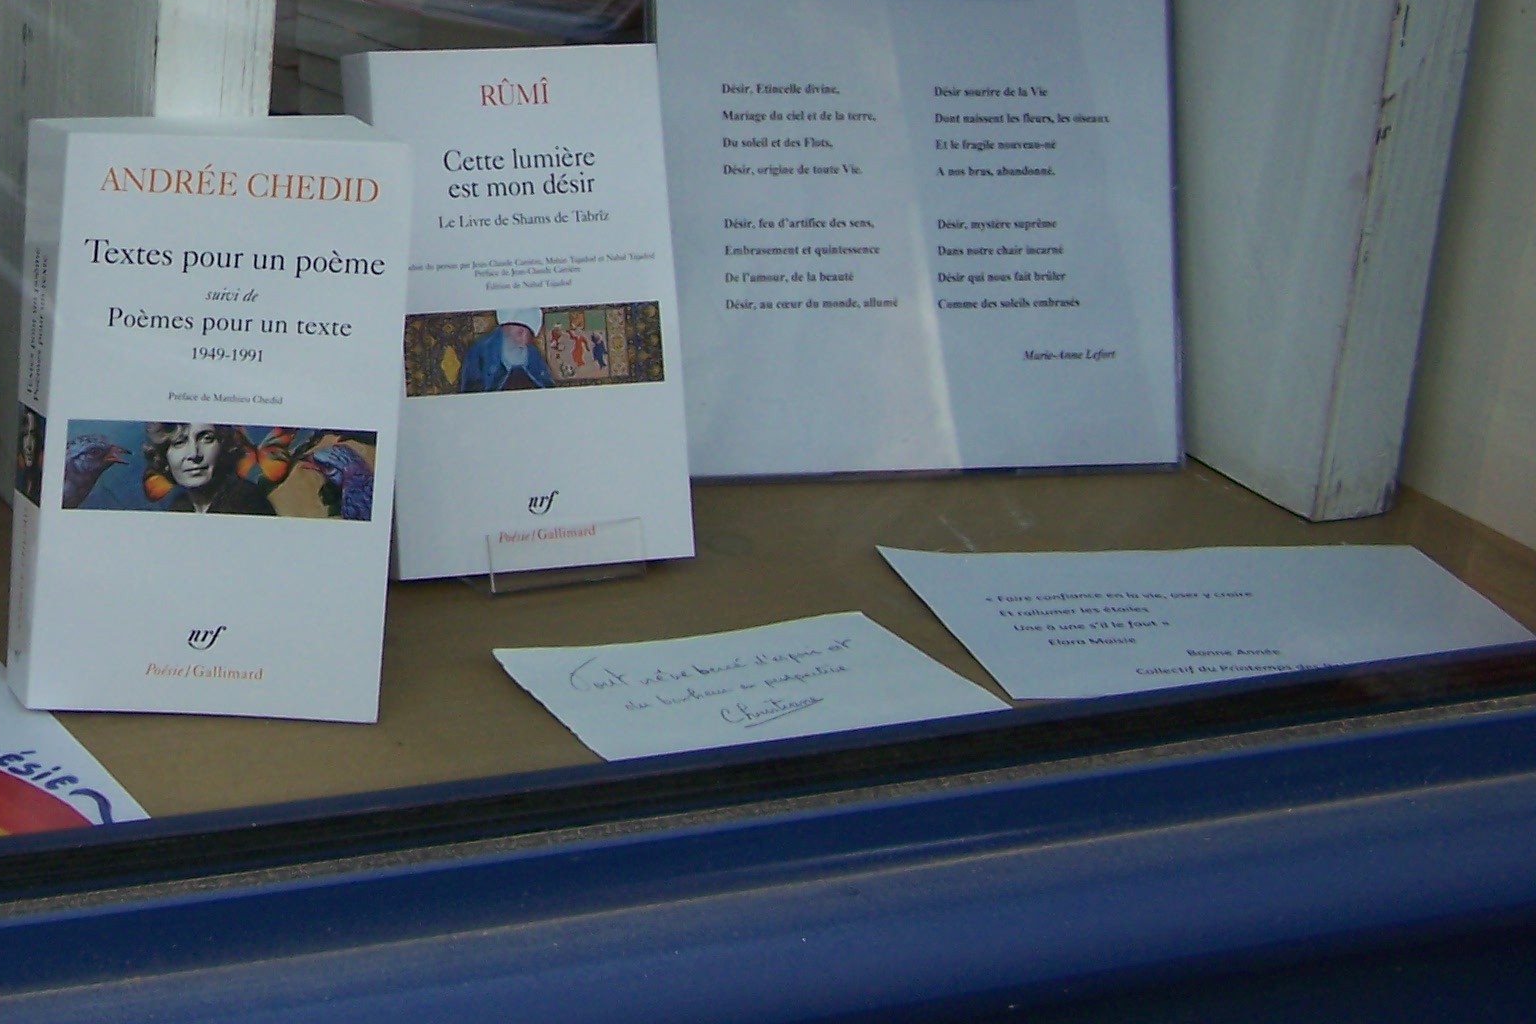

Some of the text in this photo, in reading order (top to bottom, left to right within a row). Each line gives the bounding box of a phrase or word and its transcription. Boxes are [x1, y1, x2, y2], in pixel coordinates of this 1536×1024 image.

[480, 77, 550, 106] RÛMÎ
[722, 111, 767, 122] Mariage
[769, 110, 783, 121] du
[786, 110, 804, 121] ciel
[807, 113, 816, 121] et
[820, 110, 831, 121] de
[835, 110, 844, 121] la
[723, 138, 738, 148] Du
[741, 137, 768, 148] soleil
[771, 139, 781, 148] et
[784, 137, 801, 148] des
[443, 146, 595, 172] Cette lumière
[757, 165, 794, 176] origine
[797, 164, 809, 175] de
[813, 165, 839, 175] toute
[100, 164, 379, 203] ANDRÉE CHEDID
[448, 172, 595, 199] est mon désir
[438, 216, 456, 229] Le
[459, 214, 491, 228] Livre
[494, 214, 509, 226] de
[512, 212, 551, 225] Shams
[554, 211, 569, 224] de
[84, 238, 173, 266] Textes
[182, 247, 244, 273] pour
[253, 253, 286, 271] un
[295, 250, 386, 279] poème
[205, 288, 260, 303] suivi de
[107, 307, 353, 337] Poèmes pour un texte
[191, 346, 264, 363] 1949-1991
[201, 393, 211, 402] de
[528, 490, 559, 515] nrf
[187, 625, 227, 650] nrf
[1186, 648, 1233, 657] Bonne
[1136, 666, 1194, 675] Collectif
[1198, 665, 1216, 673] du
